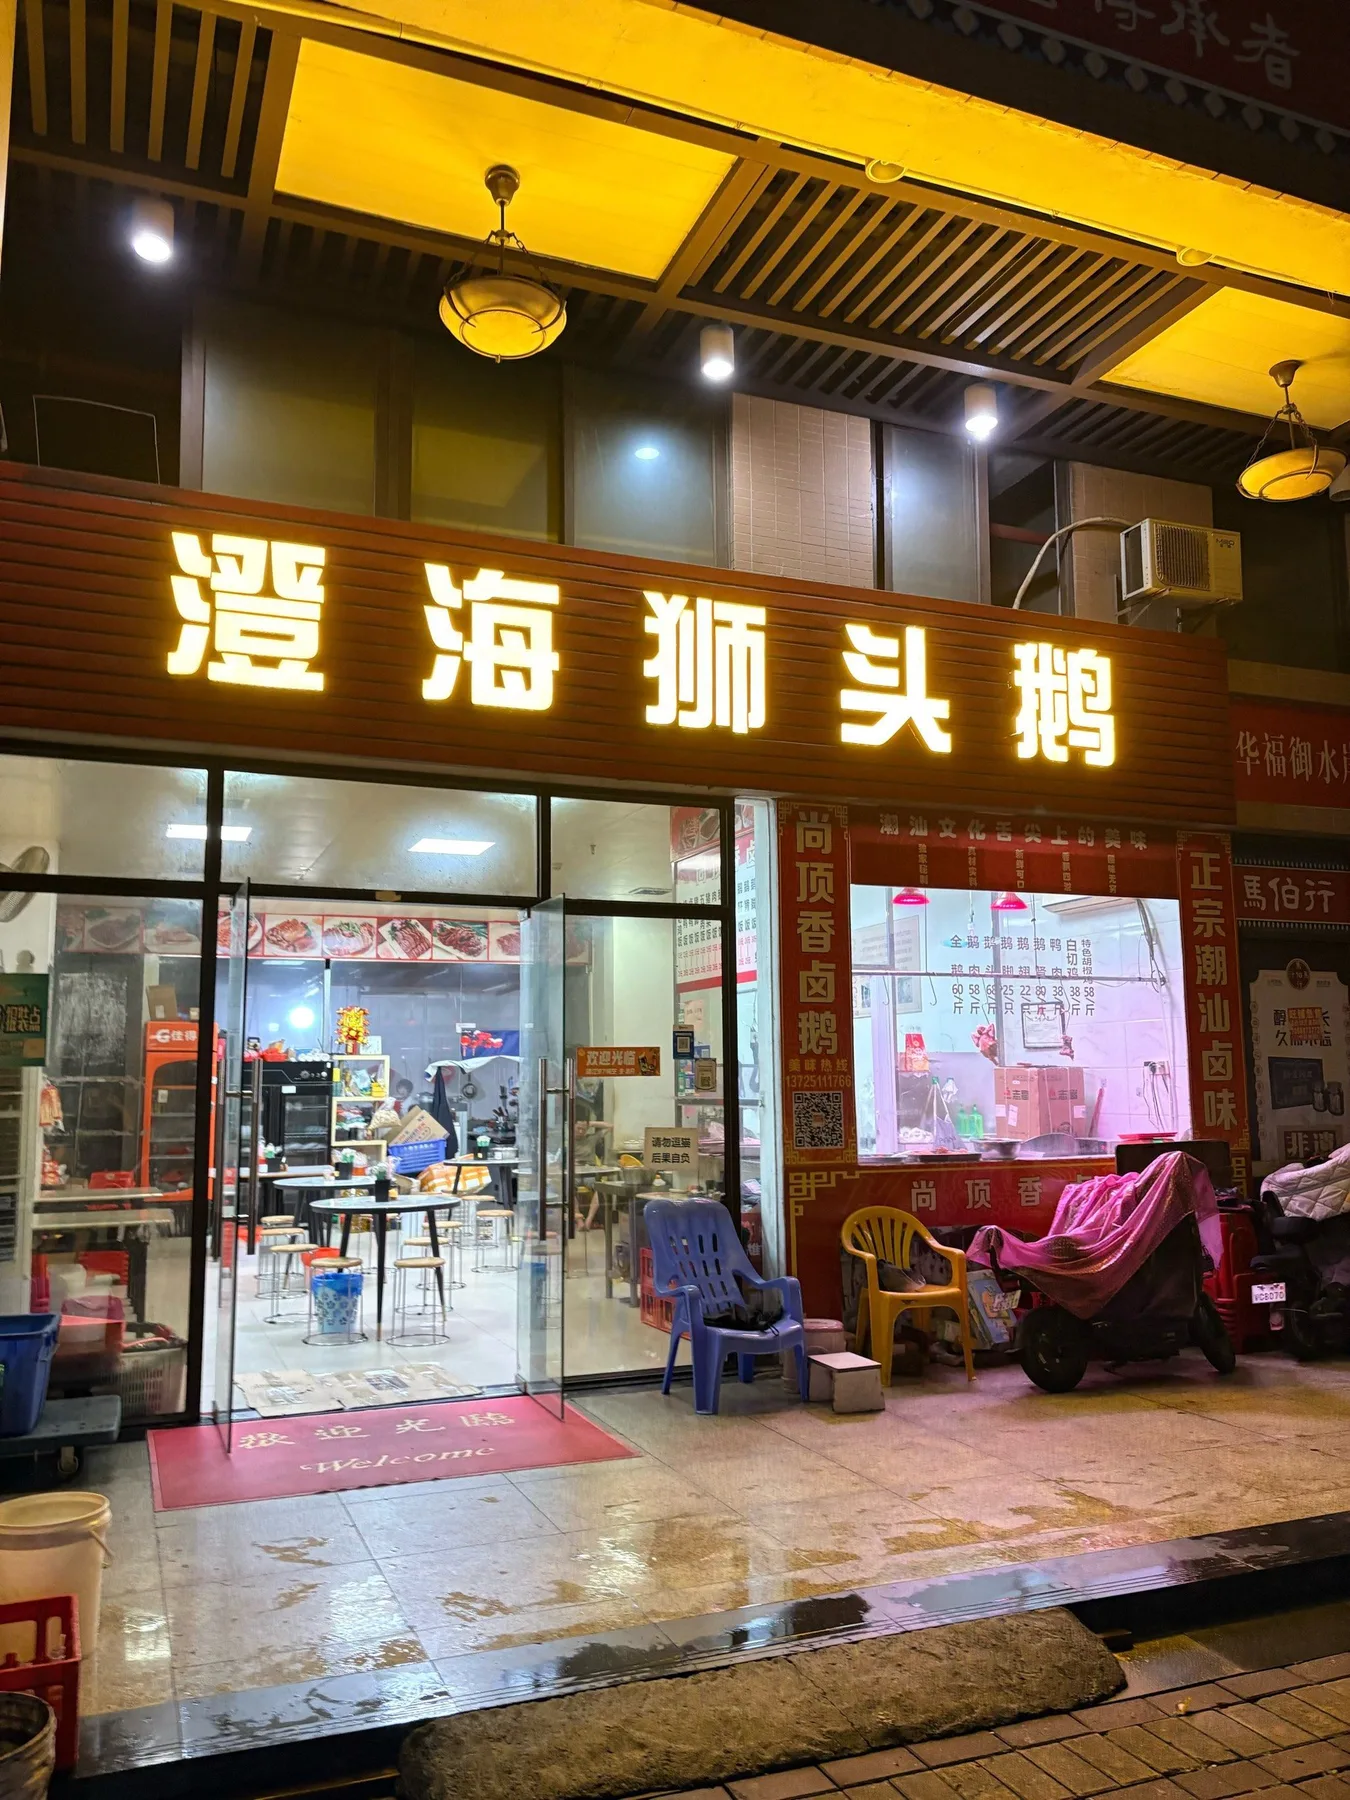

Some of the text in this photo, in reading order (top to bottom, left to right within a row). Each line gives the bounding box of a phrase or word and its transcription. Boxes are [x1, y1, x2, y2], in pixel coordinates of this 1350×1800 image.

[1034, 0, 1301, 90] 传承者
[166, 530, 1117, 768] 澄海狮头鹅
[879, 813, 1148, 851] 潮汕文化舌尖上的美味
[1014, 849, 1026, 889] 新鲜可口
[1243, 875, 1335, 913] 馬伯行
[795, 811, 837, 1055] 尚顶香卤鹅
[1190, 851, 1238, 1131] 正宗潮汕卤味
[586, 1050, 636, 1066] 欢迎光临
[788, 1059, 848, 1072] 美味热线
[652, 1153, 690, 1164] 后果自负
[911, 1175, 1092, 1212] 尚顶香
[300, 1446, 495, 1475] Welcome
